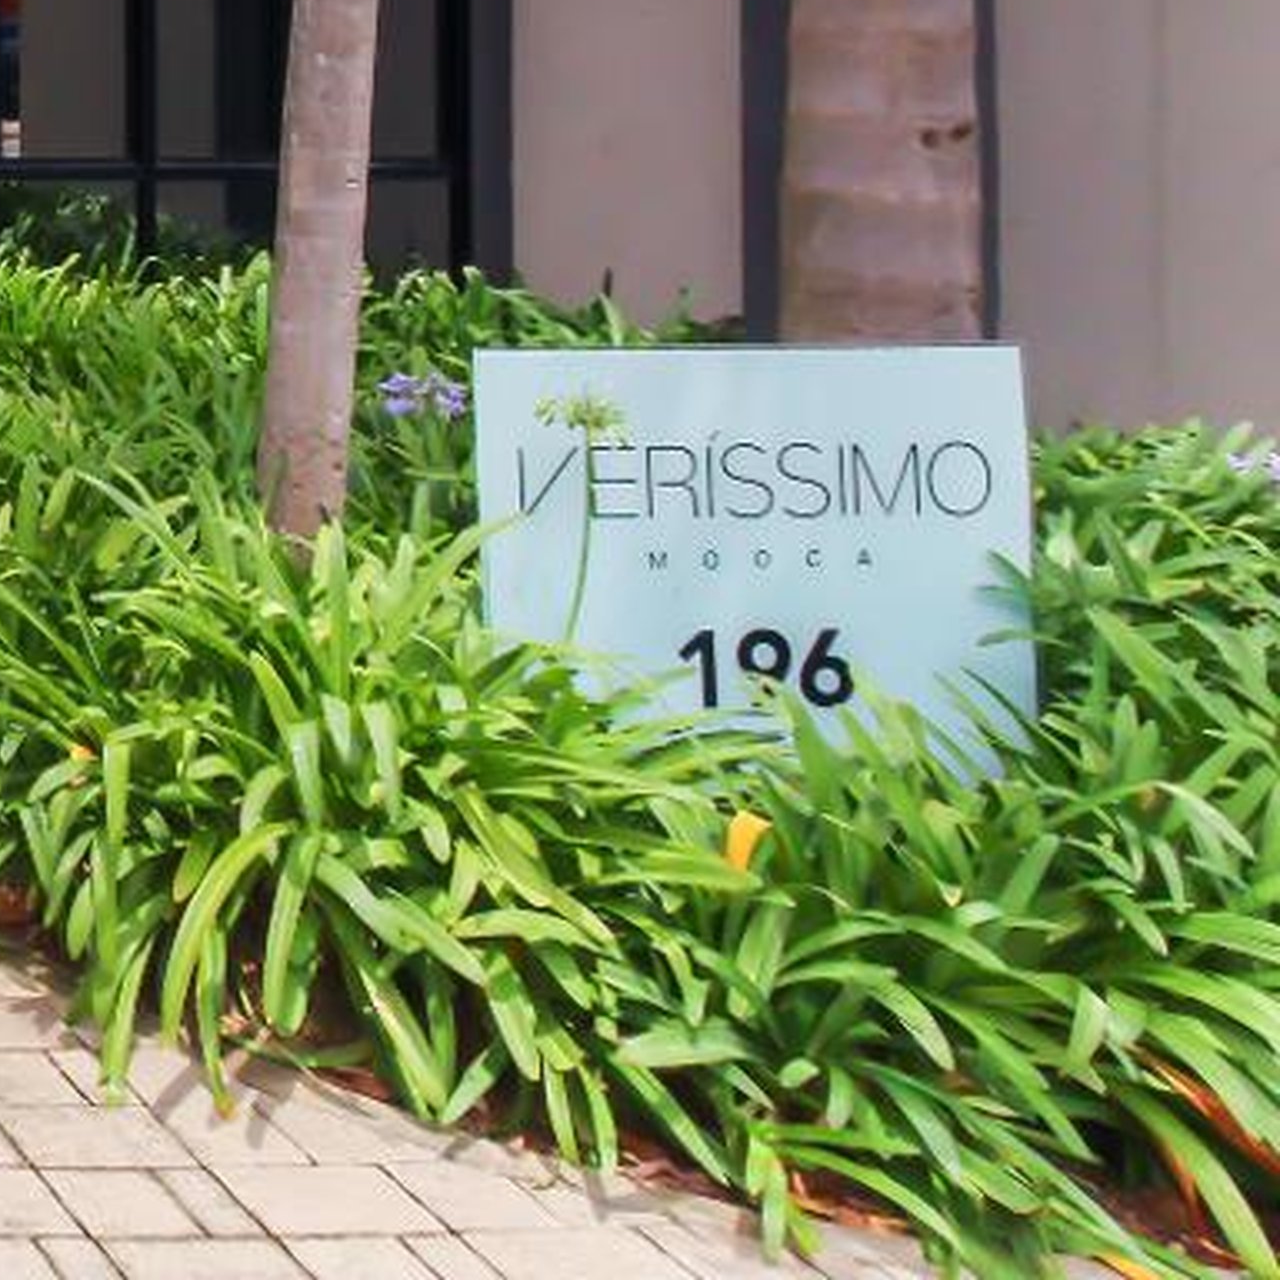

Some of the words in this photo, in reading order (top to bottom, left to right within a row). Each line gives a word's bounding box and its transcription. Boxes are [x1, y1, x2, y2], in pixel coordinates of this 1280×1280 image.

[516, 429, 993, 519] VERÍSSIMO
[647, 548, 873, 570] MOOCA
[678, 627, 856, 709] 196
